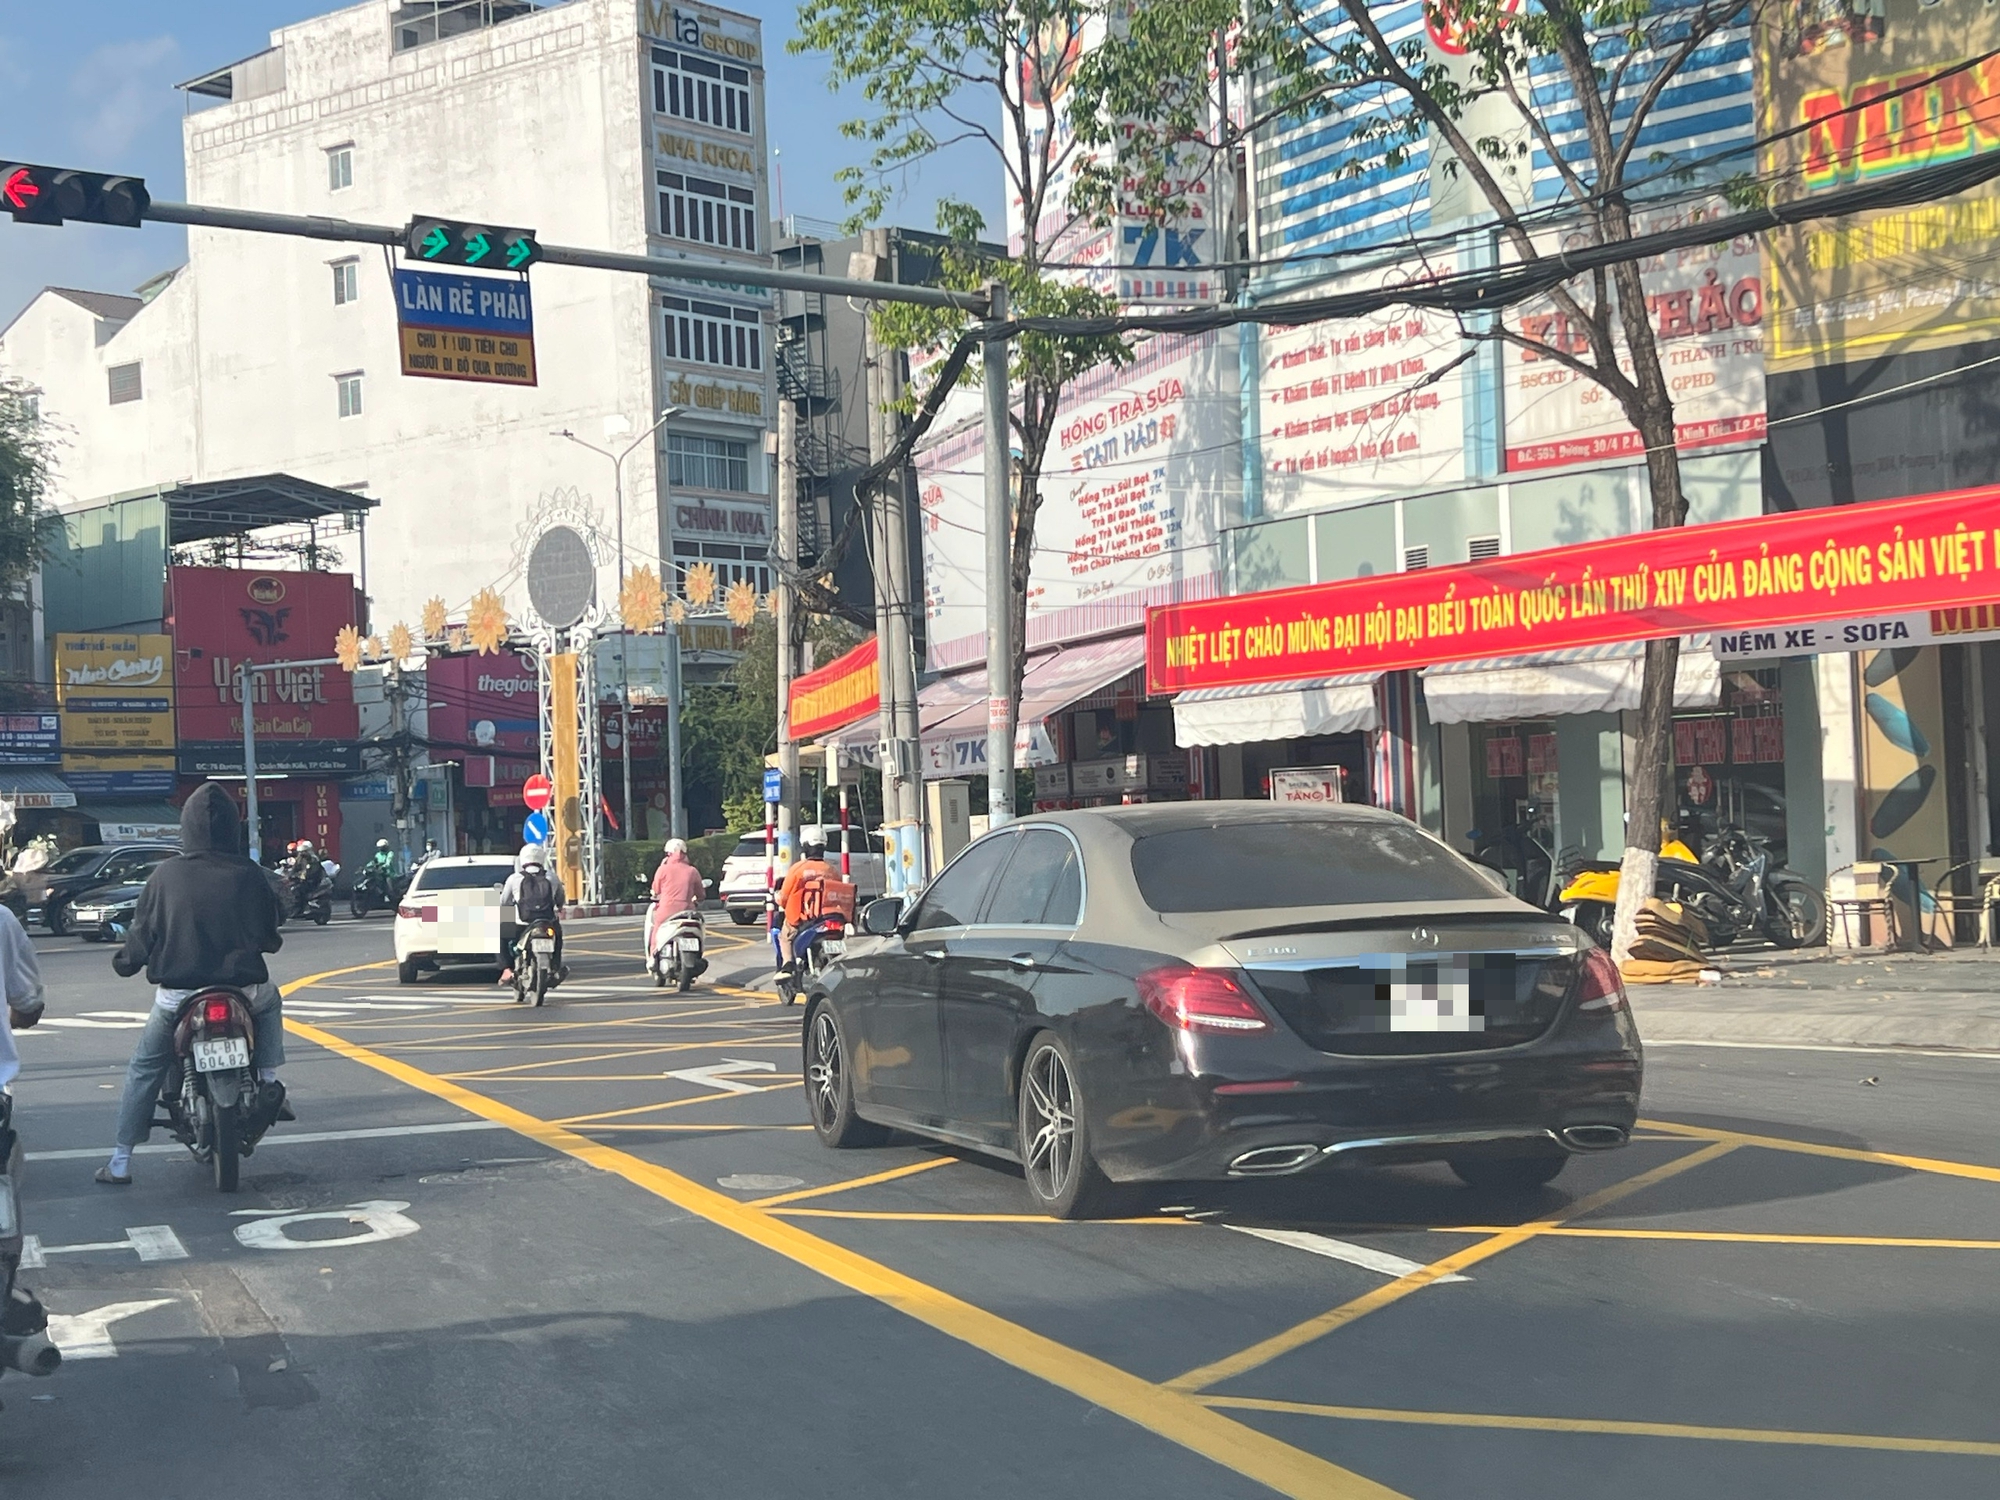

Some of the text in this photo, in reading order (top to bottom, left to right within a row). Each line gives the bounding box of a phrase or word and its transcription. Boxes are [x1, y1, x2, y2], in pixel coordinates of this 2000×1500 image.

[701, 32, 756, 60] GROUP
[1123, 226, 1206, 267] 7K
[402, 276, 527, 320] LÀN RẼ PHẢI
[472, 359, 491, 375] QUA
[1283, 384, 1308, 405] Khám
[1060, 377, 1186, 451] HỒNG TRÀ SỮA
[1593, 438, 1619, 455] 30/4
[1102, 484, 1116, 498] Trà
[1133, 472, 1150, 486] Bọt
[676, 499, 728, 533] CHỈNH
[730, 511, 766, 535] NHA
[1082, 506, 1097, 521] Lục
[1098, 500, 1113, 514] Trà
[1130, 488, 1147, 502] Bọt
[1092, 515, 1106, 529] Trà
[1139, 500, 1155, 514] 10K
[1098, 526, 1112, 541] Trà
[1160, 507, 1176, 521] 12K
[1090, 543, 1104, 557] Trà
[1129, 531, 1144, 545] Trà
[1146, 526, 1164, 541] Sữa
[1166, 520, 1183, 535] 12K
[1142, 542, 1161, 556] Kim
[1166, 522, 1987, 672] NHIỆT LIỆT CHÀO MỪNG ĐẠI HỘI ĐẠI BIỂU TOÀN QUỐC LẦN THỨ XIV CỦA ĐẢNG CỘNG SẢN VIỆT
[1720, 631, 1777, 656] NỆM
[1784, 629, 1816, 649] XE
[1843, 621, 1910, 643] SOFA
[955, 739, 988, 766] 7K
[1322, 781, 1332, 798] 1
[199, 1053, 246, 1070] 604.82
[202, 1040, 238, 1056] 64-B1
